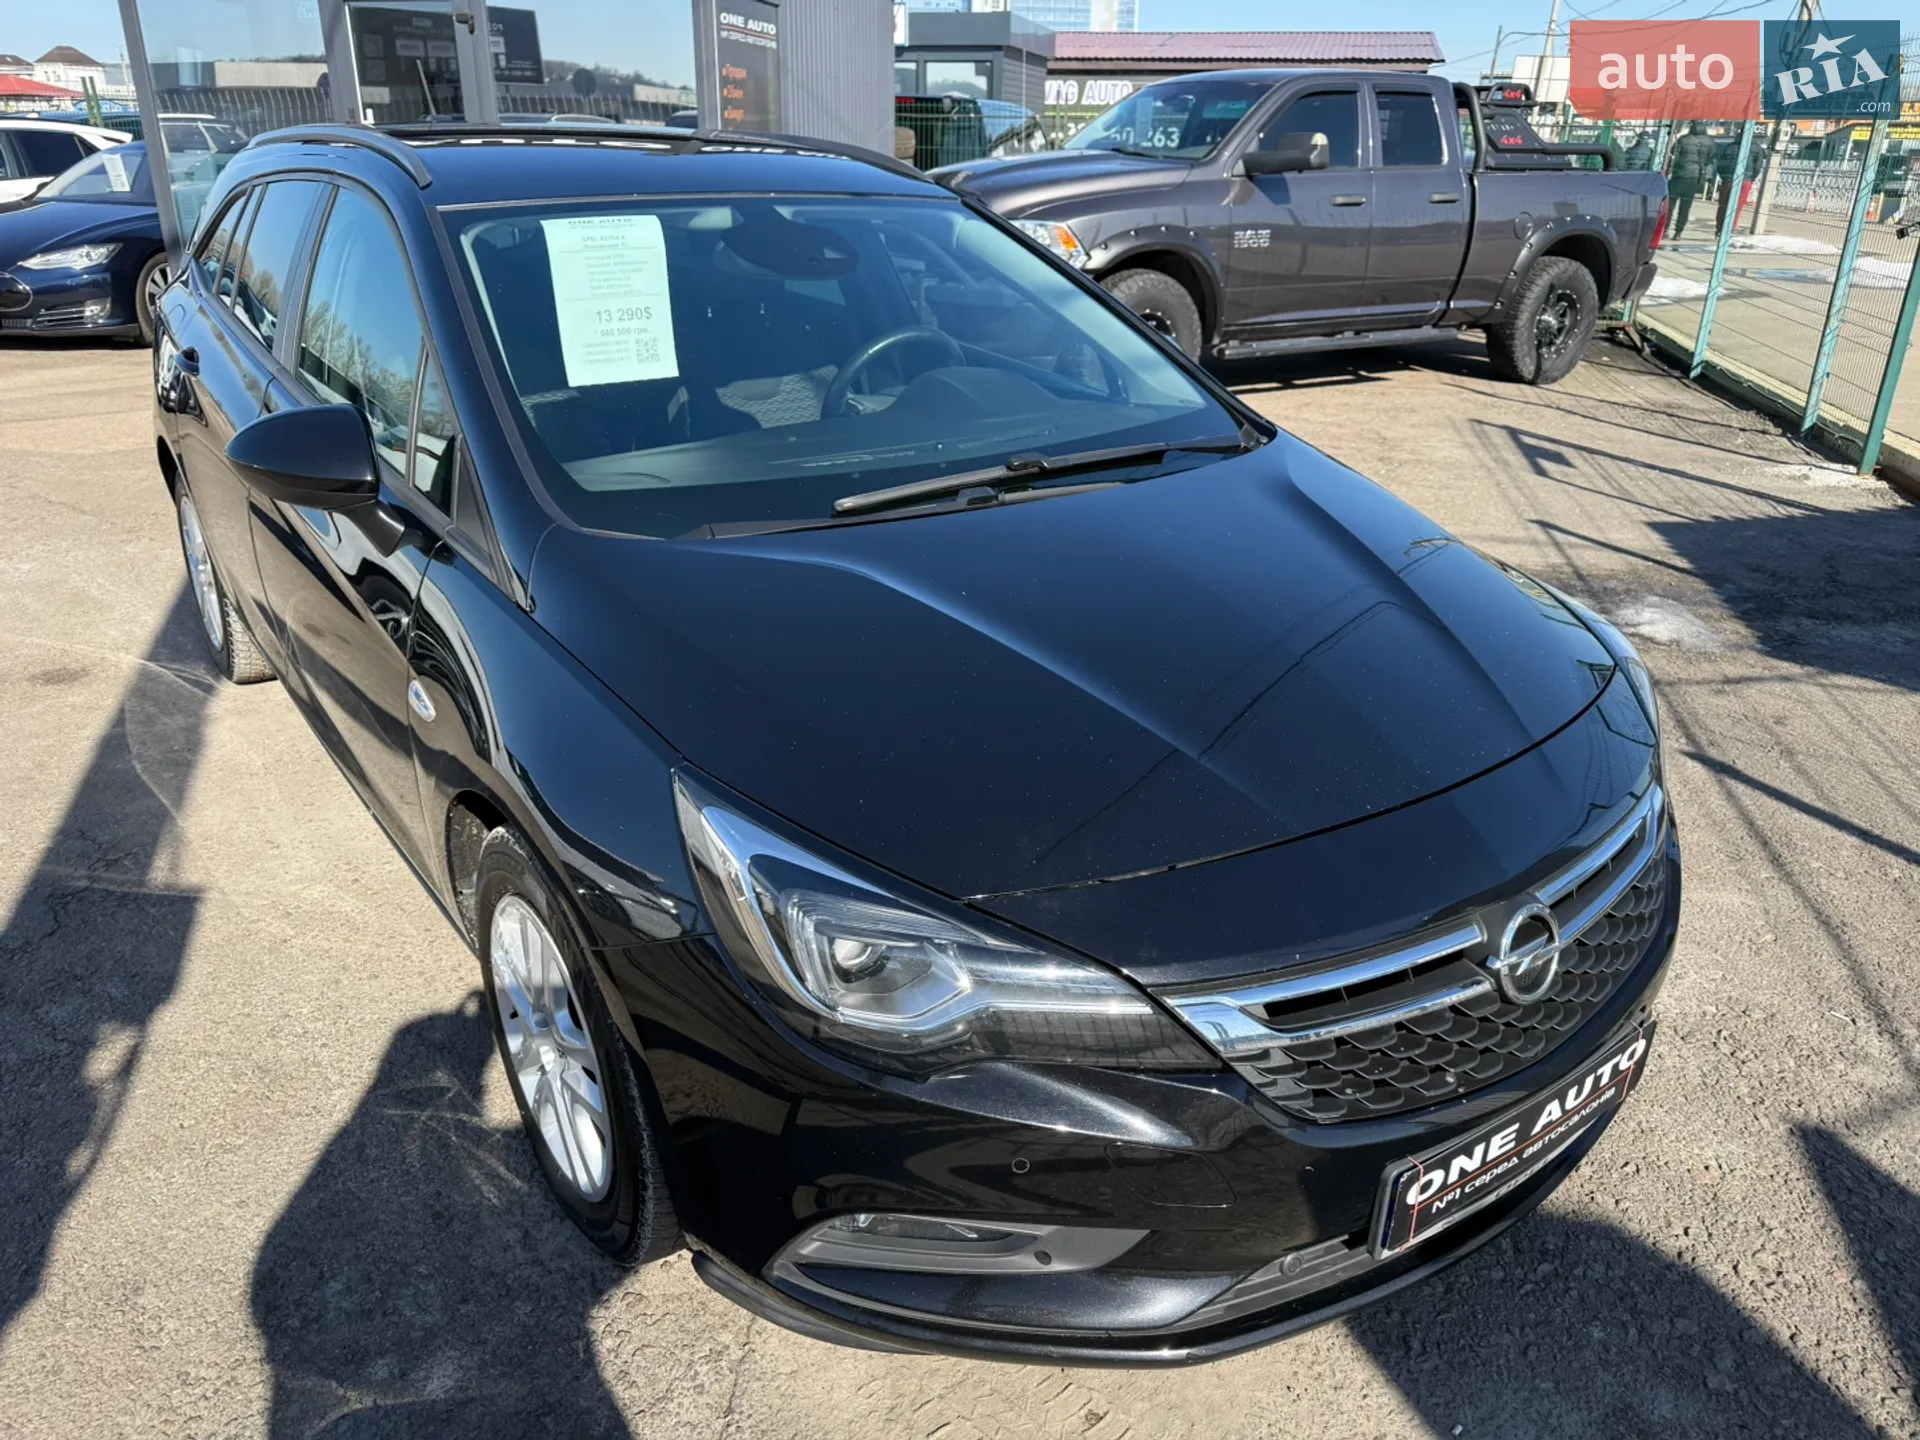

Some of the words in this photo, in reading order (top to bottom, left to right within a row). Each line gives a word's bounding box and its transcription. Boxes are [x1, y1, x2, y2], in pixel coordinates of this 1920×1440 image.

[720, 12, 745, 28] ONE
[747, 19, 776, 35] AUTO
[1500, 135, 1523, 145] 4x4
[596, 309, 613, 324] 13
[617, 305, 652, 322] 290$
[617, 327, 632, 336] 500
[1406, 1122, 1520, 1206] ONE
[1530, 1038, 1647, 1136] AUTO
[1464, 1157, 1519, 1194] серед
